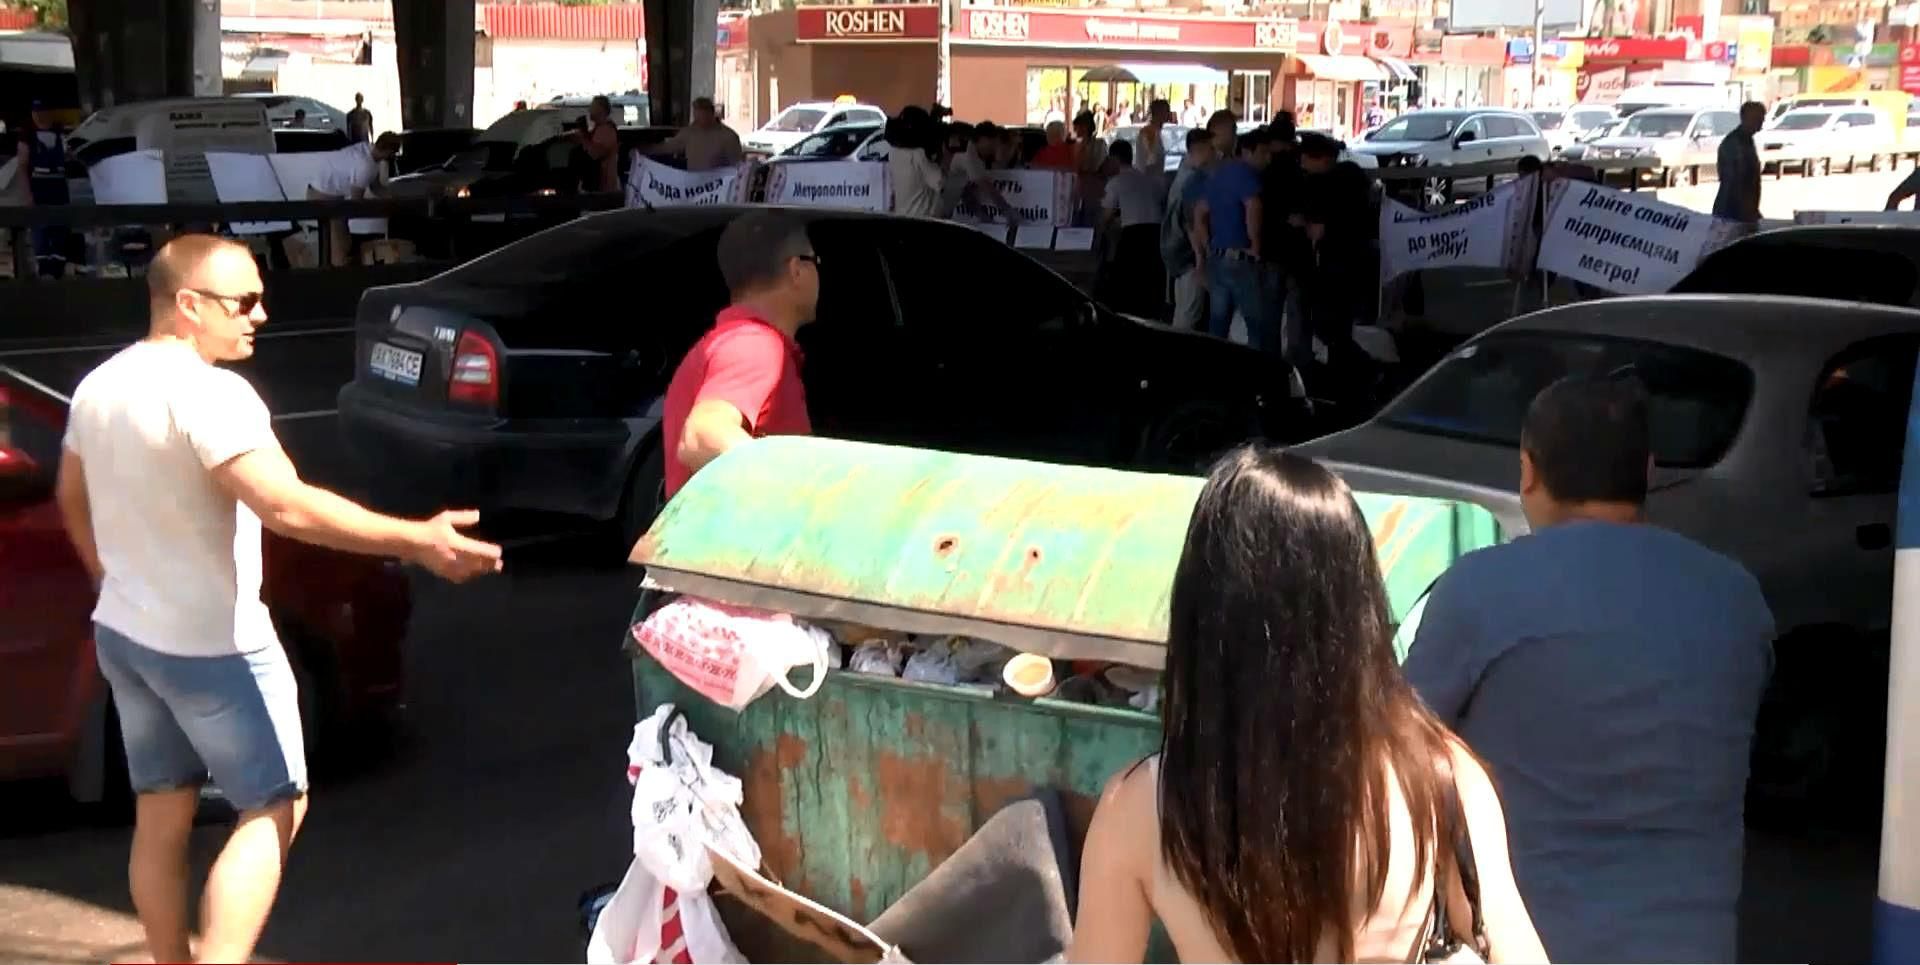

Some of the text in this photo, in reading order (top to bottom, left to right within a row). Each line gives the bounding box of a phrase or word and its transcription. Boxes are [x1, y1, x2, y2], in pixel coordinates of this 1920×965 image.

[825, 9, 905, 36] ROSHEN
[970, 12, 1030, 38] ROSHEN
[1579, 187, 1690, 233] Дайте спокій
[1564, 216, 1680, 265] підприємцям
[1577, 253, 1641, 285] метро!
